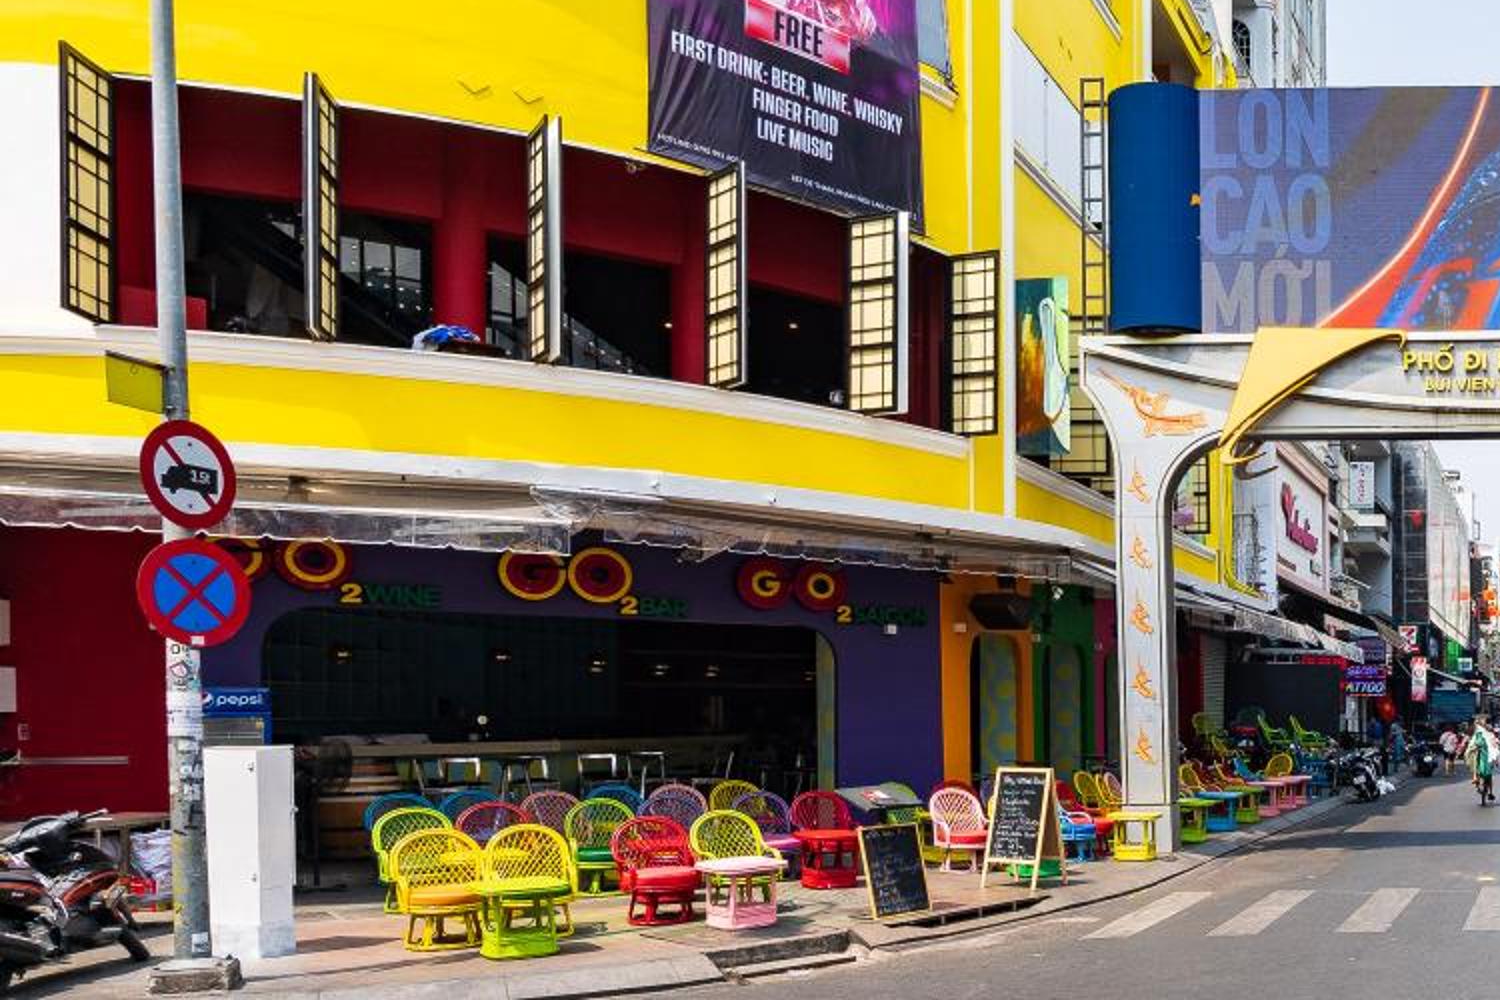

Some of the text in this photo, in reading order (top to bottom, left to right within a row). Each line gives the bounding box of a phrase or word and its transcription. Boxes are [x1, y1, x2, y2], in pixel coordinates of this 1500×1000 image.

[773, 9, 824, 58] FREE
[671, 31, 714, 63] FIRST
[717, 48, 769, 85] DRINK:
[853, 96, 904, 137] WHISKY
[752, 87, 839, 137] FINGER FOOD
[1200, 88, 1329, 169] LON
[757, 117, 833, 161] LIVE MUSIC
[1200, 173, 1332, 255] CAO
[1403, 344, 1455, 372] PHỐ
[1464, 350, 1487, 372] ĐI
[1456, 375, 1495, 393] VIEN
[216, 693, 262, 706] pepsi
